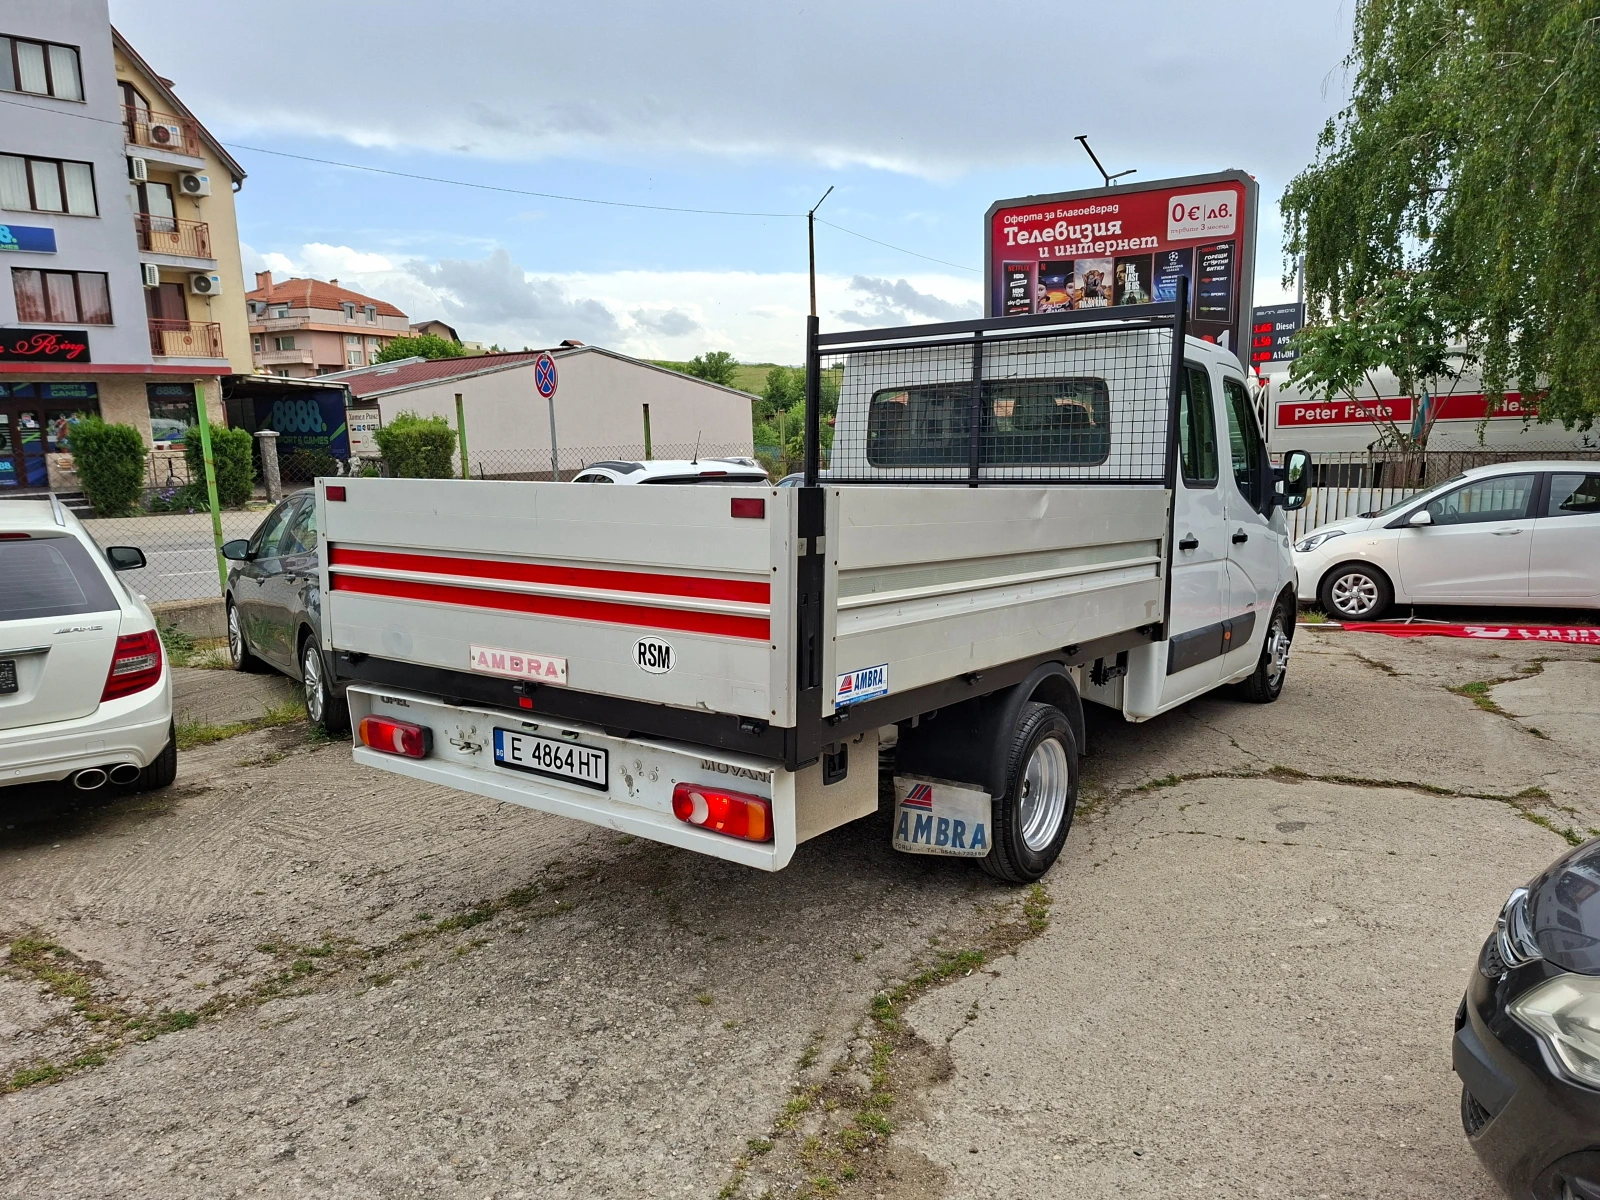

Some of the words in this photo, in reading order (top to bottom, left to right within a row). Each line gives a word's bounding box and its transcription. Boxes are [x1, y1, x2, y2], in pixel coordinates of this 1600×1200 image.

[1004, 212, 1042, 224] Оферта
[1044, 211, 1054, 221] за
[1057, 204, 1119, 218] Благоевград
[1172, 203, 1185, 222] 0
[1188, 206, 1200, 220] €
[1207, 203, 1232, 218] лв.
[1004, 220, 1122, 246] Телевизия
[1039, 246, 1050, 258] и
[1054, 236, 1158, 256] интернет
[1125, 273, 1139, 281] LAST
[1126, 264, 1136, 273] THE
[1276, 322, 1295, 330] Diesel
[10, 334, 86, 359] Ring
[1295, 407, 1337, 421] Peter
[304, 436, 329, 444] GAMES
[477, 651, 559, 678] AMBRA
[638, 642, 670, 669] RSM
[854, 668, 882, 691] AMBRA
[512, 737, 522, 761] E
[532, 742, 574, 773] 4864
[579, 750, 602, 778] HT
[896, 812, 987, 850] AMBRA
